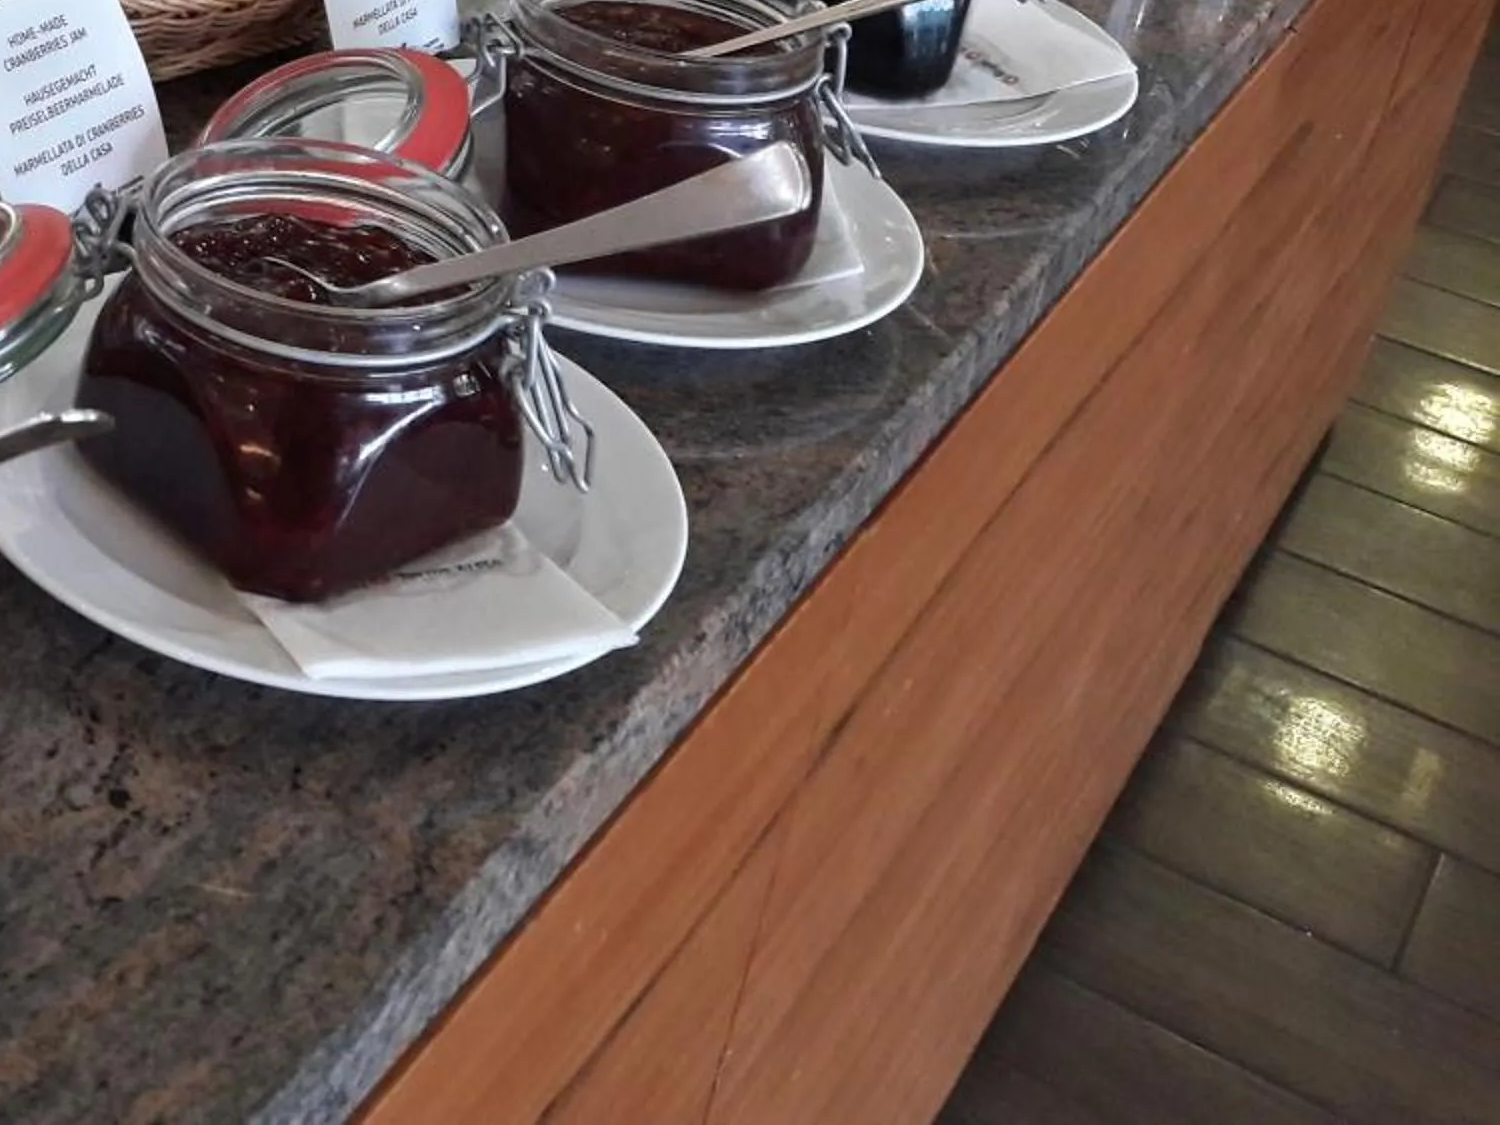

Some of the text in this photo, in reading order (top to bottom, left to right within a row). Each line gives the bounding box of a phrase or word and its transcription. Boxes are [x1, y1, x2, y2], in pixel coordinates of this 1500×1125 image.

[3, 27, 88, 73] CRANBERRIES JAM
[6, 14, 69, 48] HOME-MADE
[23, 64, 98, 106] HAUSEGEMACHT
[14, 104, 146, 177] MARMELLATA DI CRANBERRIES
[61, 142, 113, 177] DELLA CASA
